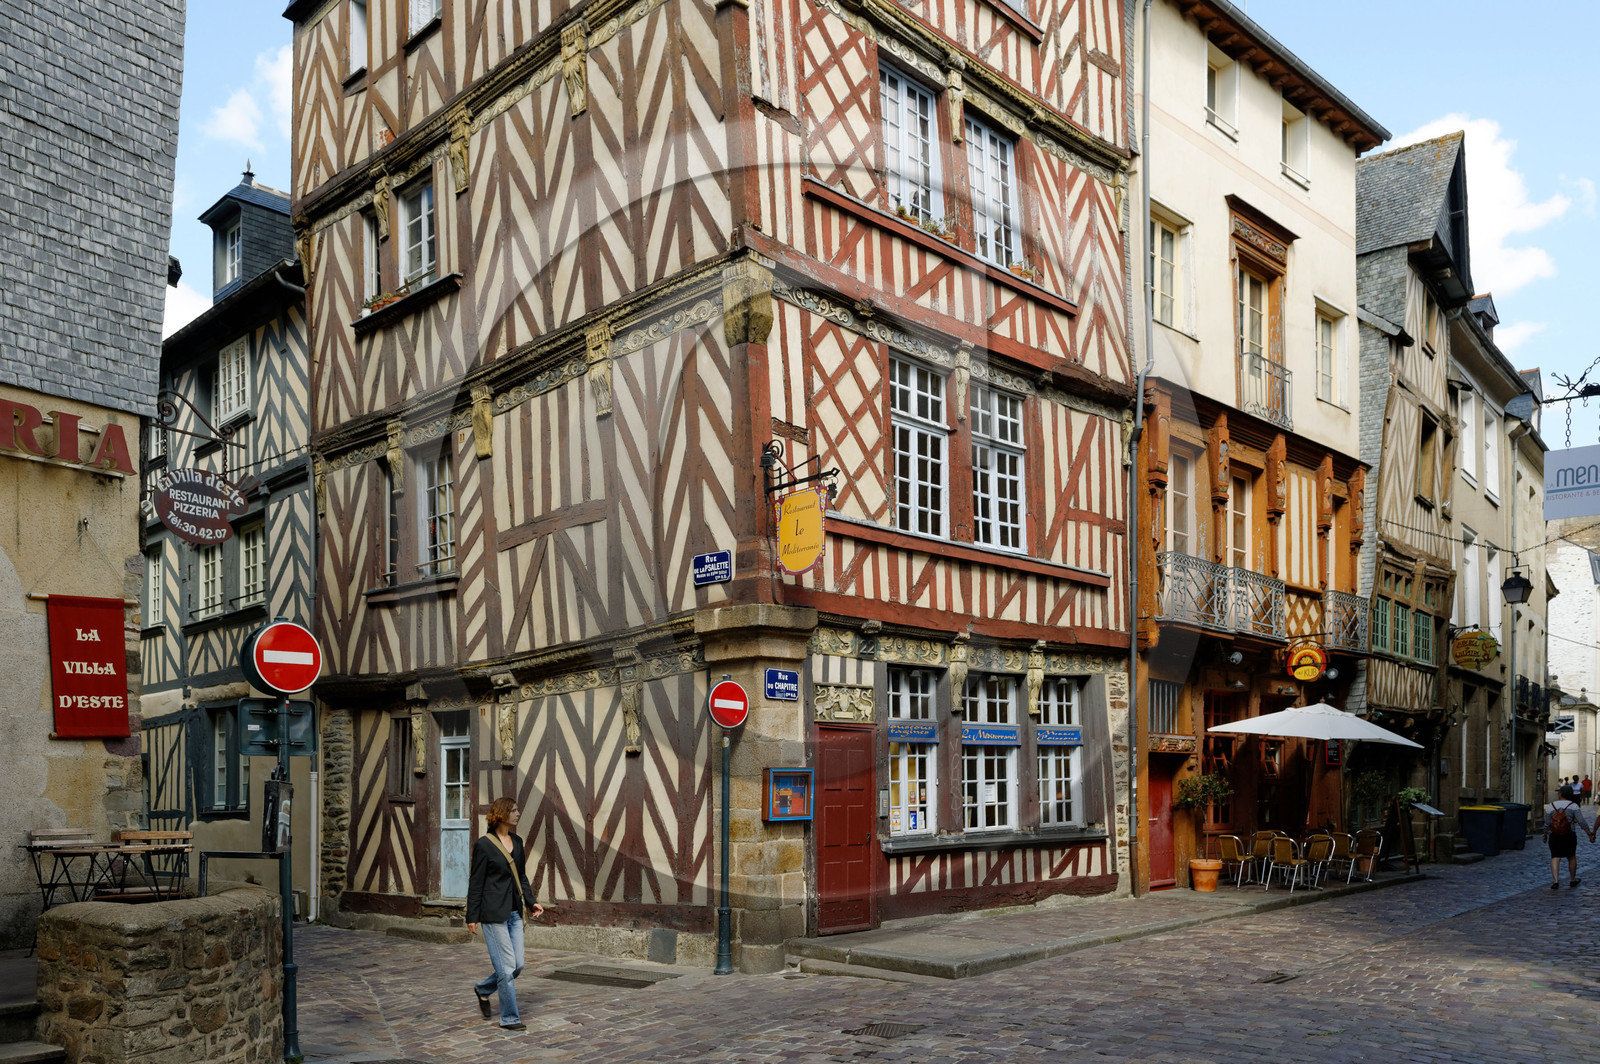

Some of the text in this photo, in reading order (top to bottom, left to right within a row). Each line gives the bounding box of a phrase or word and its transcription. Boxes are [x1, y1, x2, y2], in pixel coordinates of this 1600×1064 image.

[0, 398, 138, 476] RIA
[170, 469, 203, 484] Villa
[205, 473, 245, 507] d'este
[169, 489, 231, 510] RESTAURANT
[1545, 491, 1584, 501] RISTORANTE
[173, 502, 220, 520] PIZZERIA
[783, 500, 816, 515] Restaurant
[704, 561, 729, 572] PSALETTE
[76, 628, 101, 642] LA
[860, 639, 875, 653] 22
[62, 661, 117, 675] VILLA
[774, 681, 798, 692] CHAPITRE
[59, 695, 124, 709] D'ESTE
[962, 728, 971, 739] Le
